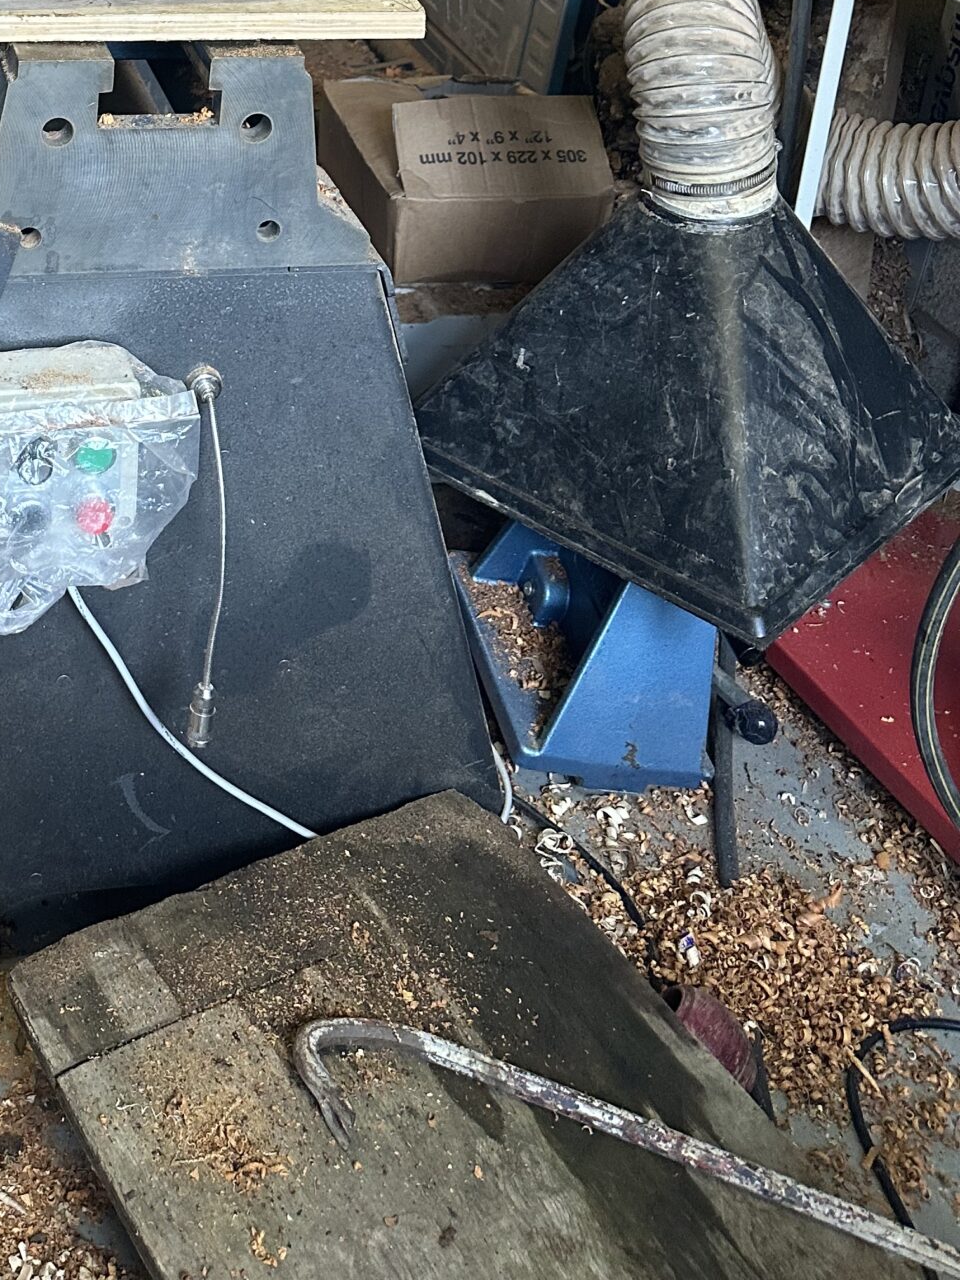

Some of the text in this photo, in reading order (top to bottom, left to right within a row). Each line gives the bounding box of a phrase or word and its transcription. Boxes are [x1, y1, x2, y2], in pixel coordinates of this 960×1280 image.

[470, 131, 481, 142] x
[508, 130, 519, 141] x
[419, 149, 587, 165] 305 x 229 x 102 mm
